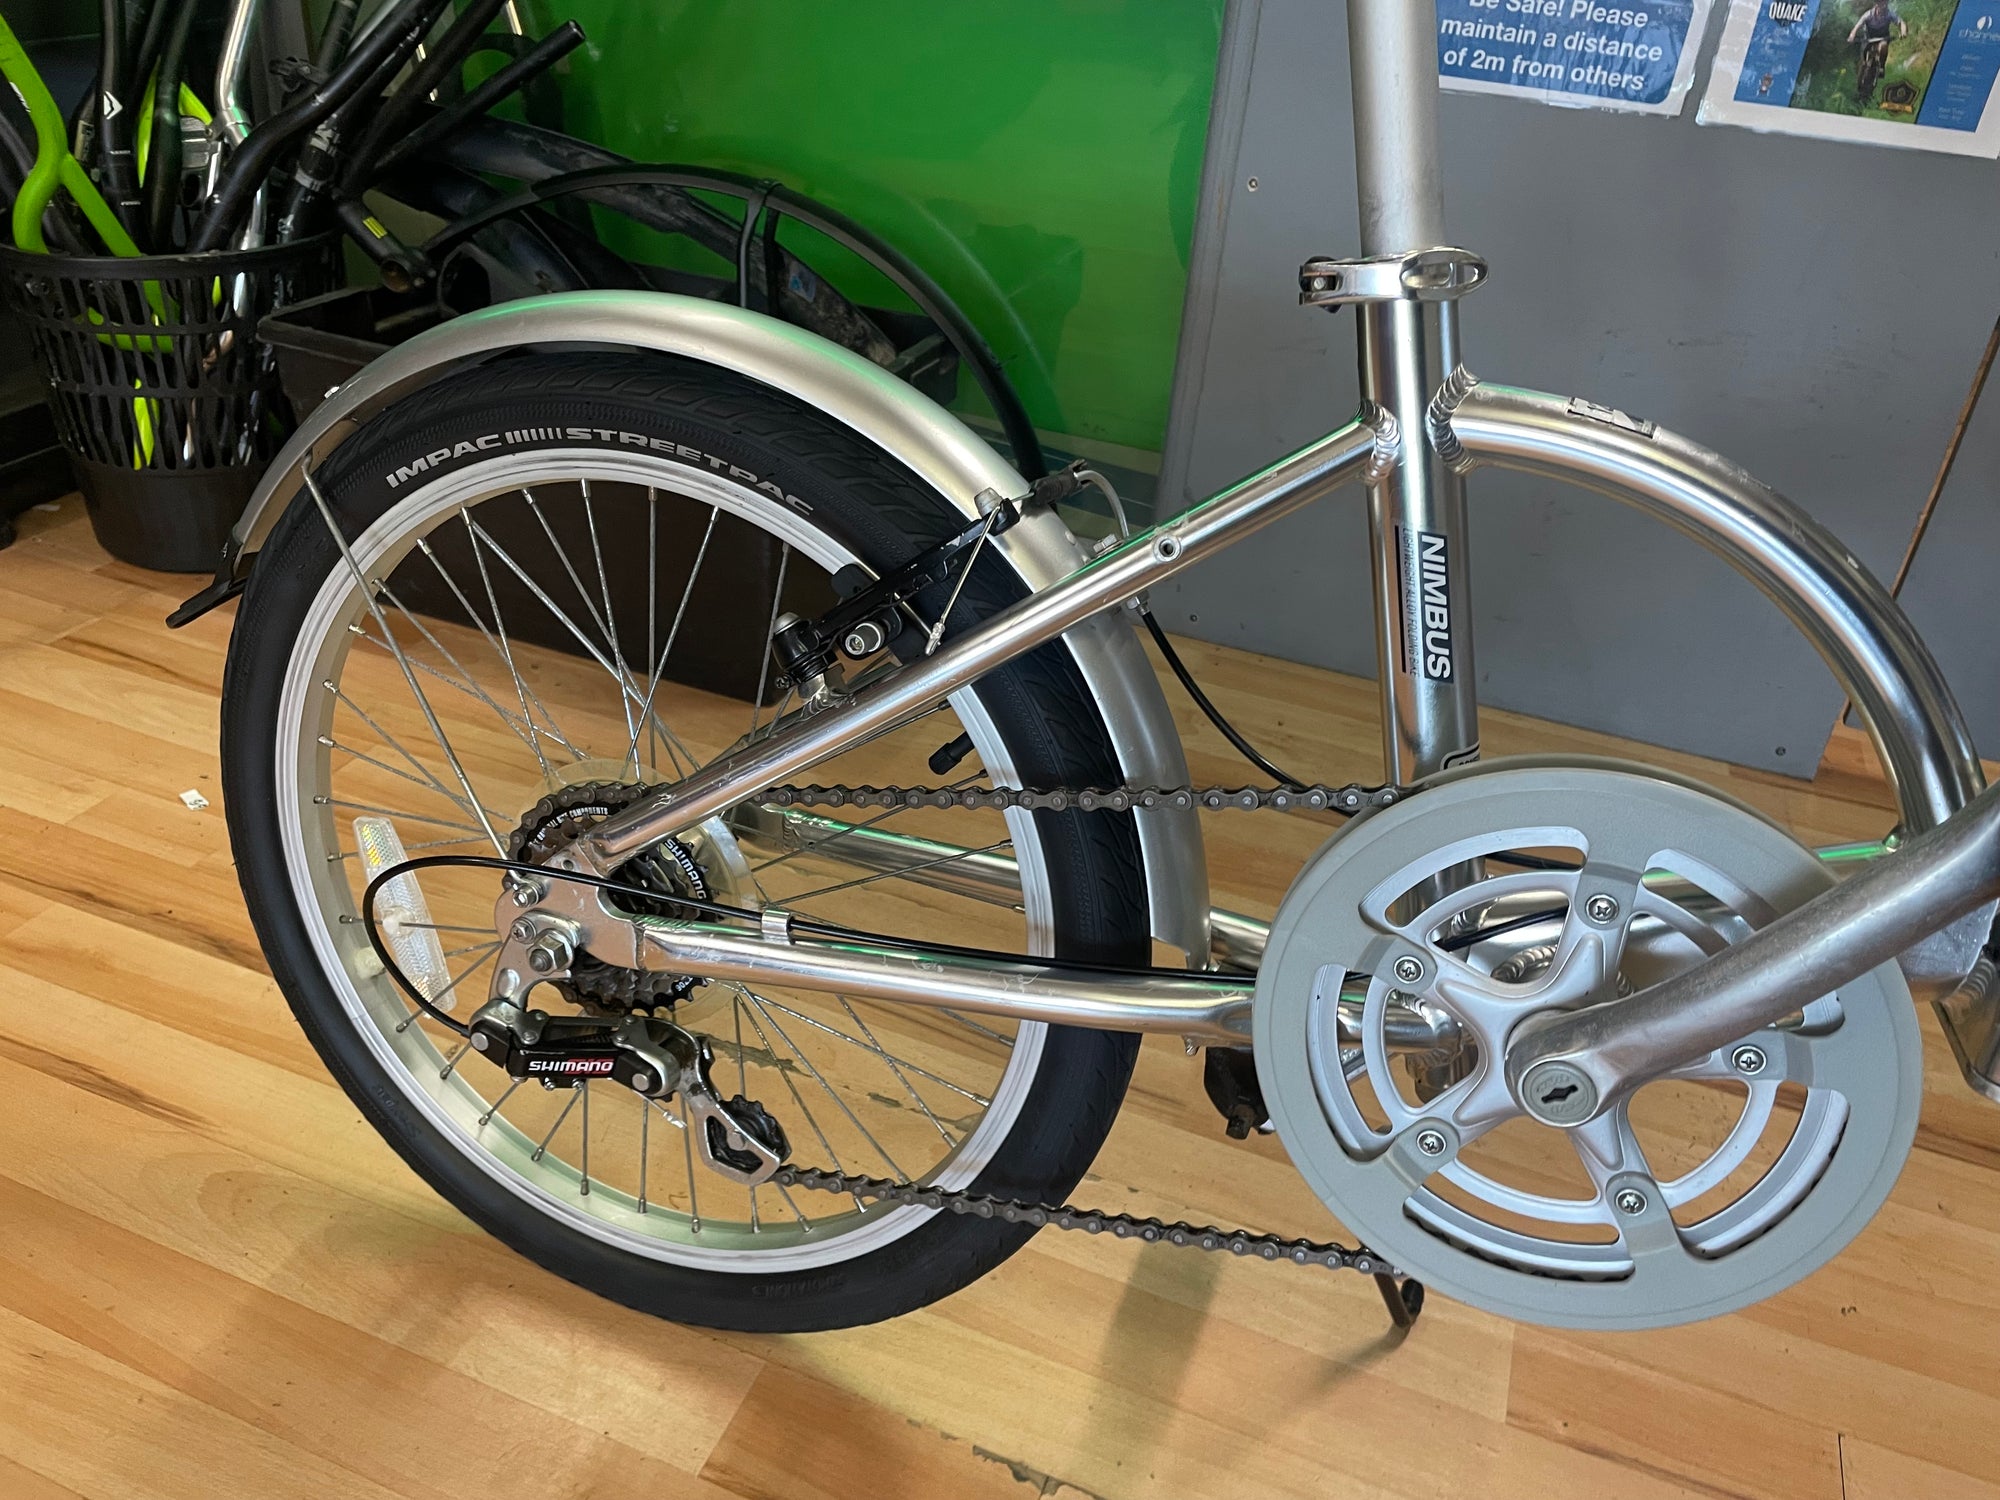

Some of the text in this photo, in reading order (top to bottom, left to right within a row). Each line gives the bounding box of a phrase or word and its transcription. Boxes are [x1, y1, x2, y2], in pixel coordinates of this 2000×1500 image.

[1570, 0, 1648, 27] Please
[1769, 2, 1808, 21] QUAKE
[1441, 19, 1662, 61] maintain a distance
[1443, 48, 1644, 90] of 2m from others
[385, 427, 814, 516] IMPAC STREETPAC
[1421, 534, 1450, 678] NIMBUS
[528, 1061, 613, 1071] SHIMANO
